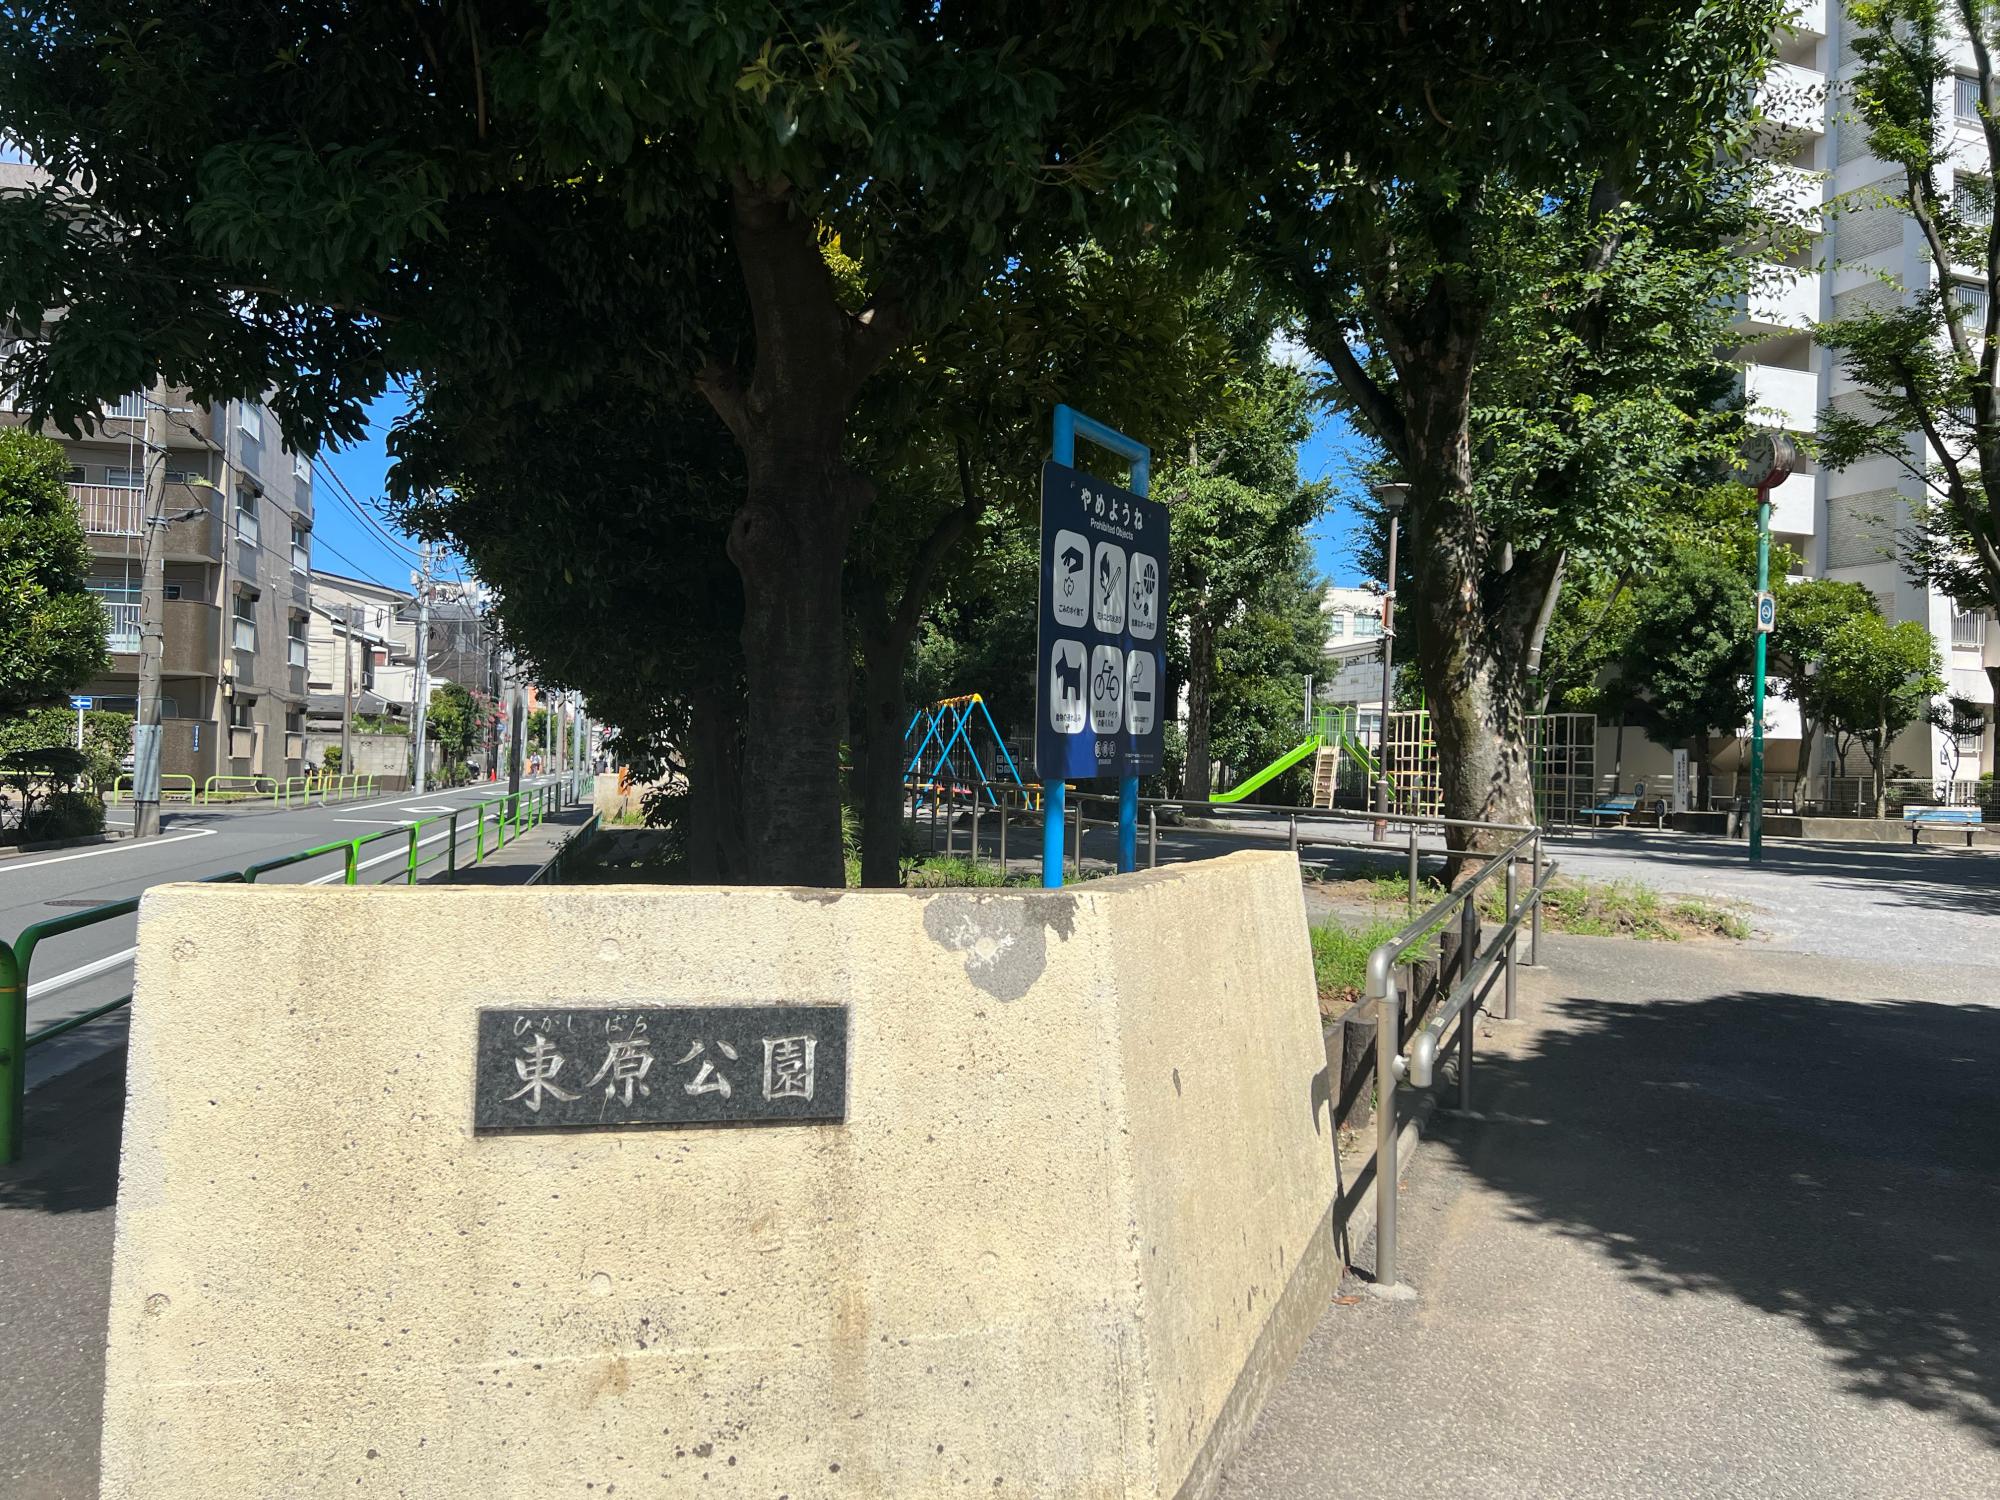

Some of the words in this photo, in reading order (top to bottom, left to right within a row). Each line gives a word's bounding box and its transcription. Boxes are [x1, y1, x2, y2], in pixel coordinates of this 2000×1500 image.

[1081, 487, 1143, 530] やめようね
[1090, 517, 1115, 535] Prohibited
[512, 1014, 576, 1037] ひがし
[500, 1033, 818, 1112] 東原公園
